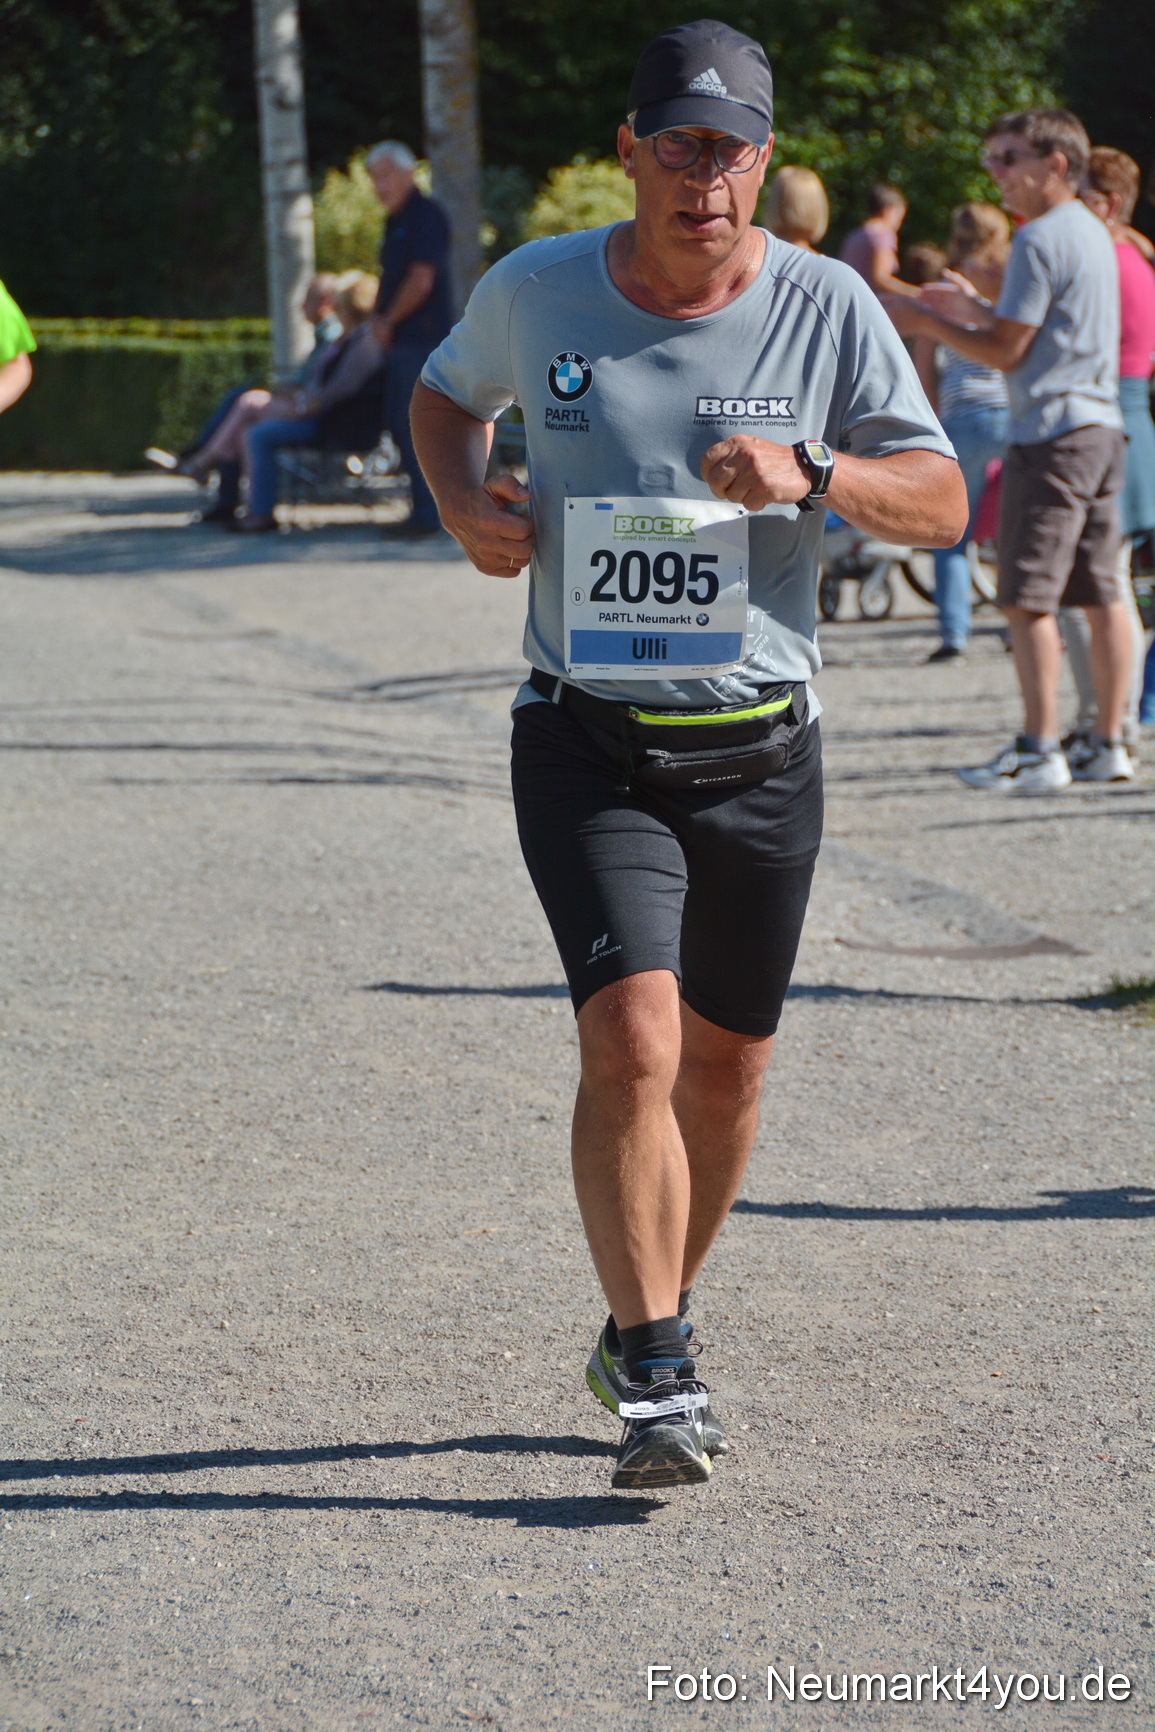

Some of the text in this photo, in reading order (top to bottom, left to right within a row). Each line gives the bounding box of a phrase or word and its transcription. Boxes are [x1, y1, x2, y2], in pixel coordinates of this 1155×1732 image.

[688, 81, 727, 94] adidas
[552, 353, 590, 371] BMW
[695, 396, 796, 418] BOCK
[545, 408, 590, 423] PARTL
[544, 420, 590, 432] Neumarkt
[693, 417, 797, 428] inspired by smart concepts
[614, 515, 696, 536] BOCK
[613, 534, 637, 542] inspired
[638, 534, 646, 542] by
[590, 549, 720, 606] 2095
[574, 591, 581, 602] D
[598, 612, 634, 623] PARTL
[636, 613, 692, 625] Neumarkt
[632, 637, 667, 660] Ulli
[598, 945, 622, 957] TOUCH
